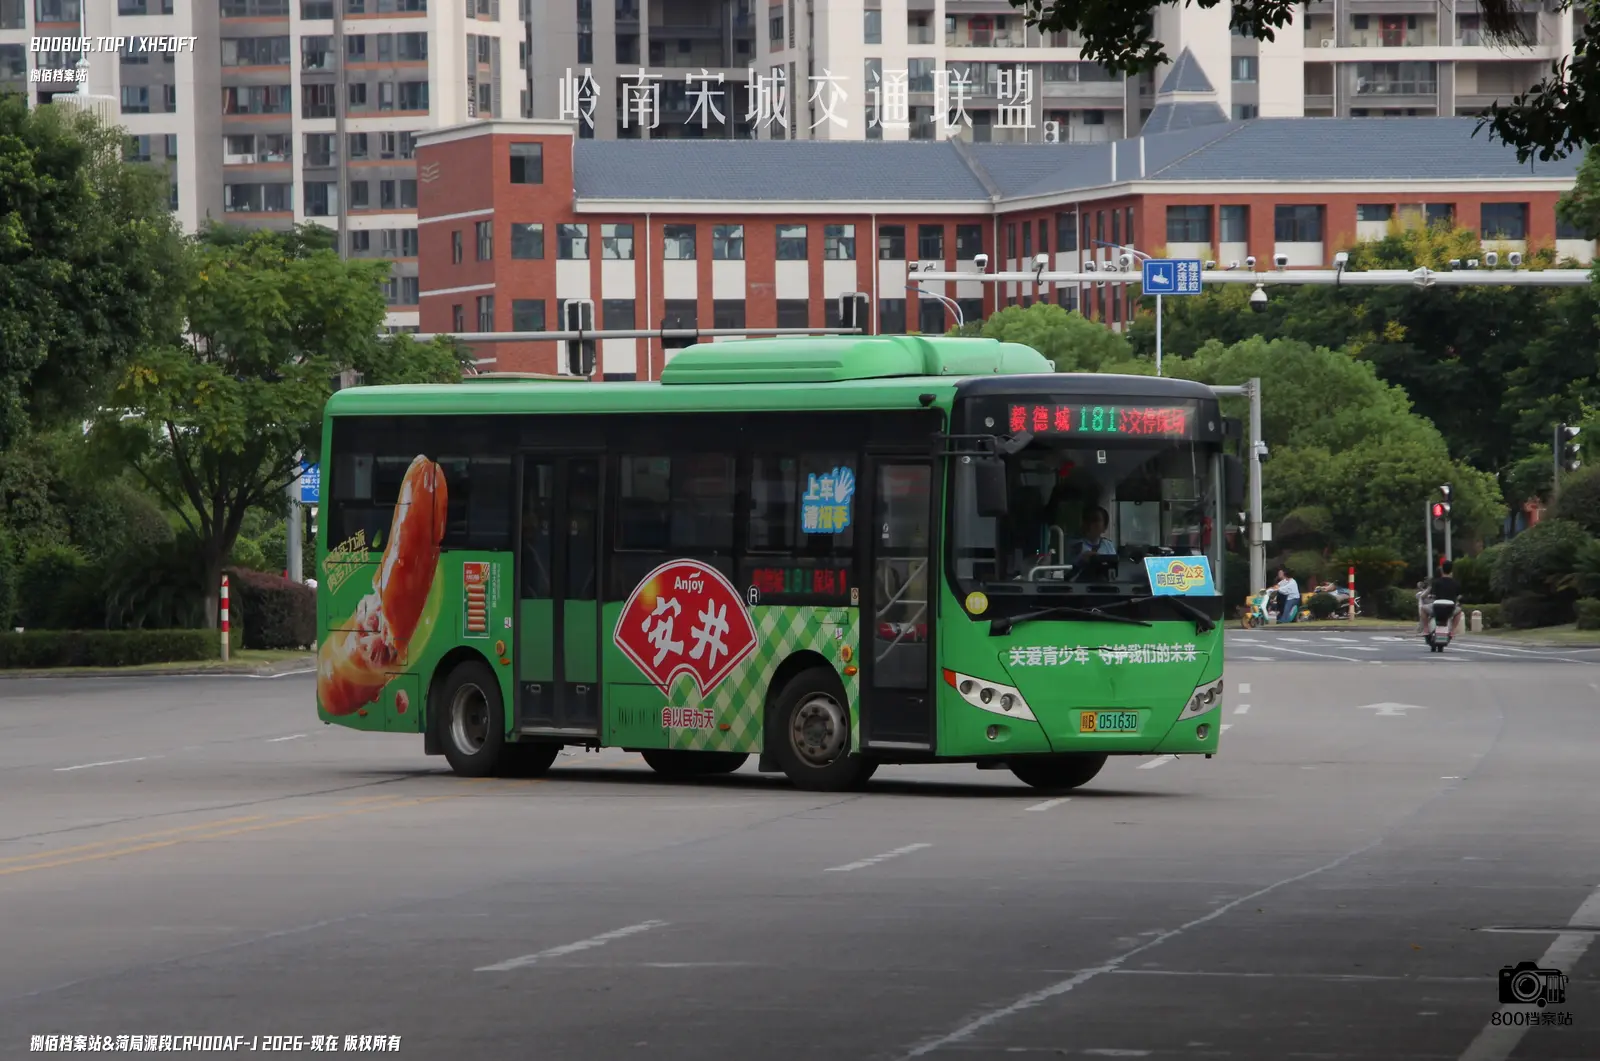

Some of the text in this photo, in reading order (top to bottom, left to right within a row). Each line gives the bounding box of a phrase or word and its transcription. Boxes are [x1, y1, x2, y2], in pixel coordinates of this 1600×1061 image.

[1177, 262, 1198, 272] 交通
[1079, 406, 1117, 432] 181
[674, 571, 704, 594] Anjoy
[1185, 566, 1204, 579] 公交
[641, 597, 730, 670] 安井
[1009, 643, 1196, 666] 关爱青少年 守护我们的未来
[662, 706, 715, 728] 食以民为天
